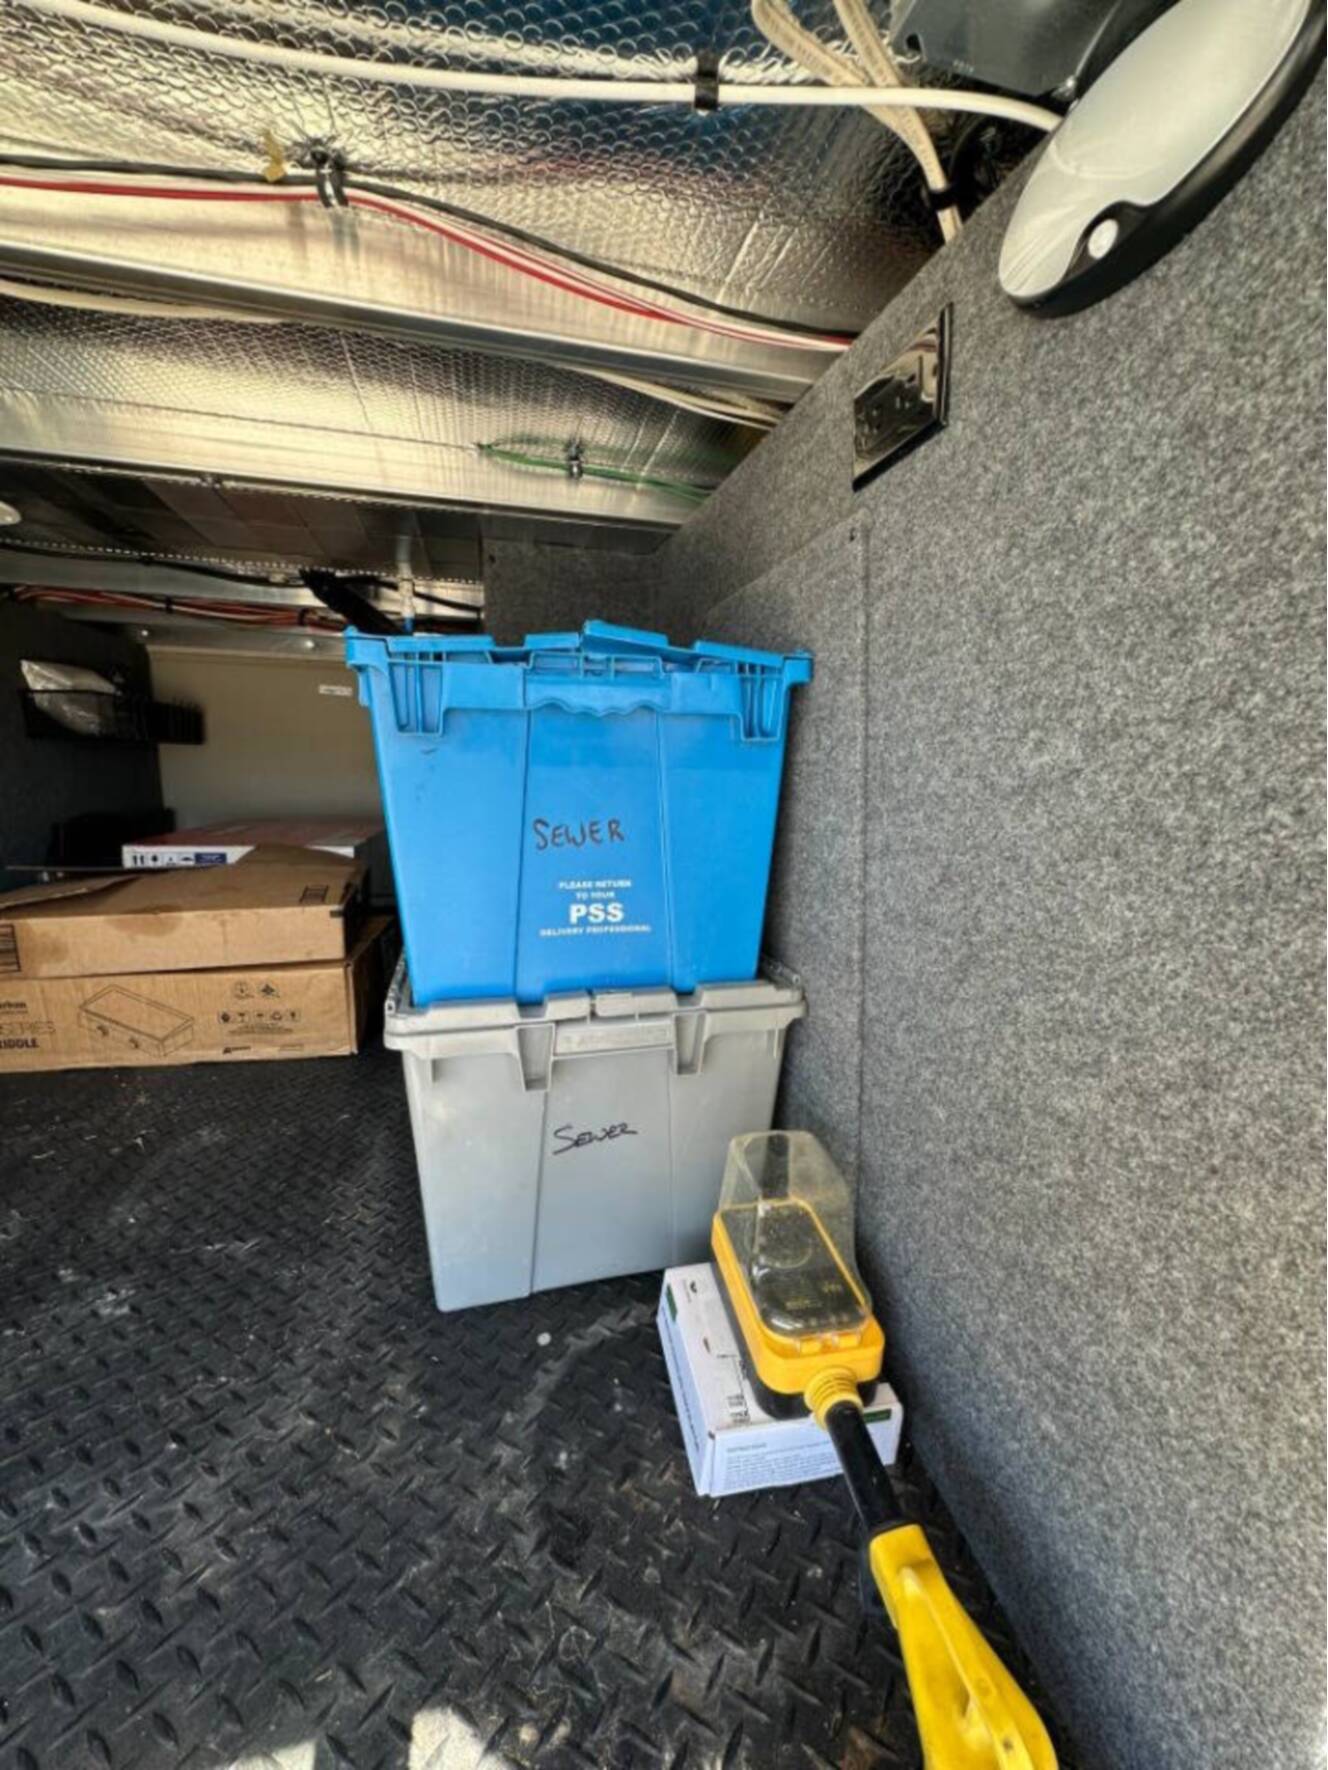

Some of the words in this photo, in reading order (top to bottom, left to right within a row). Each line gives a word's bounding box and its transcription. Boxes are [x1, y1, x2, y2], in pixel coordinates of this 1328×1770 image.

[533, 817, 625, 851] SEWER
[559, 880, 593, 890] PLEASE
[595, 879, 632, 889] RETURN
[569, 902, 625, 925] PSS
